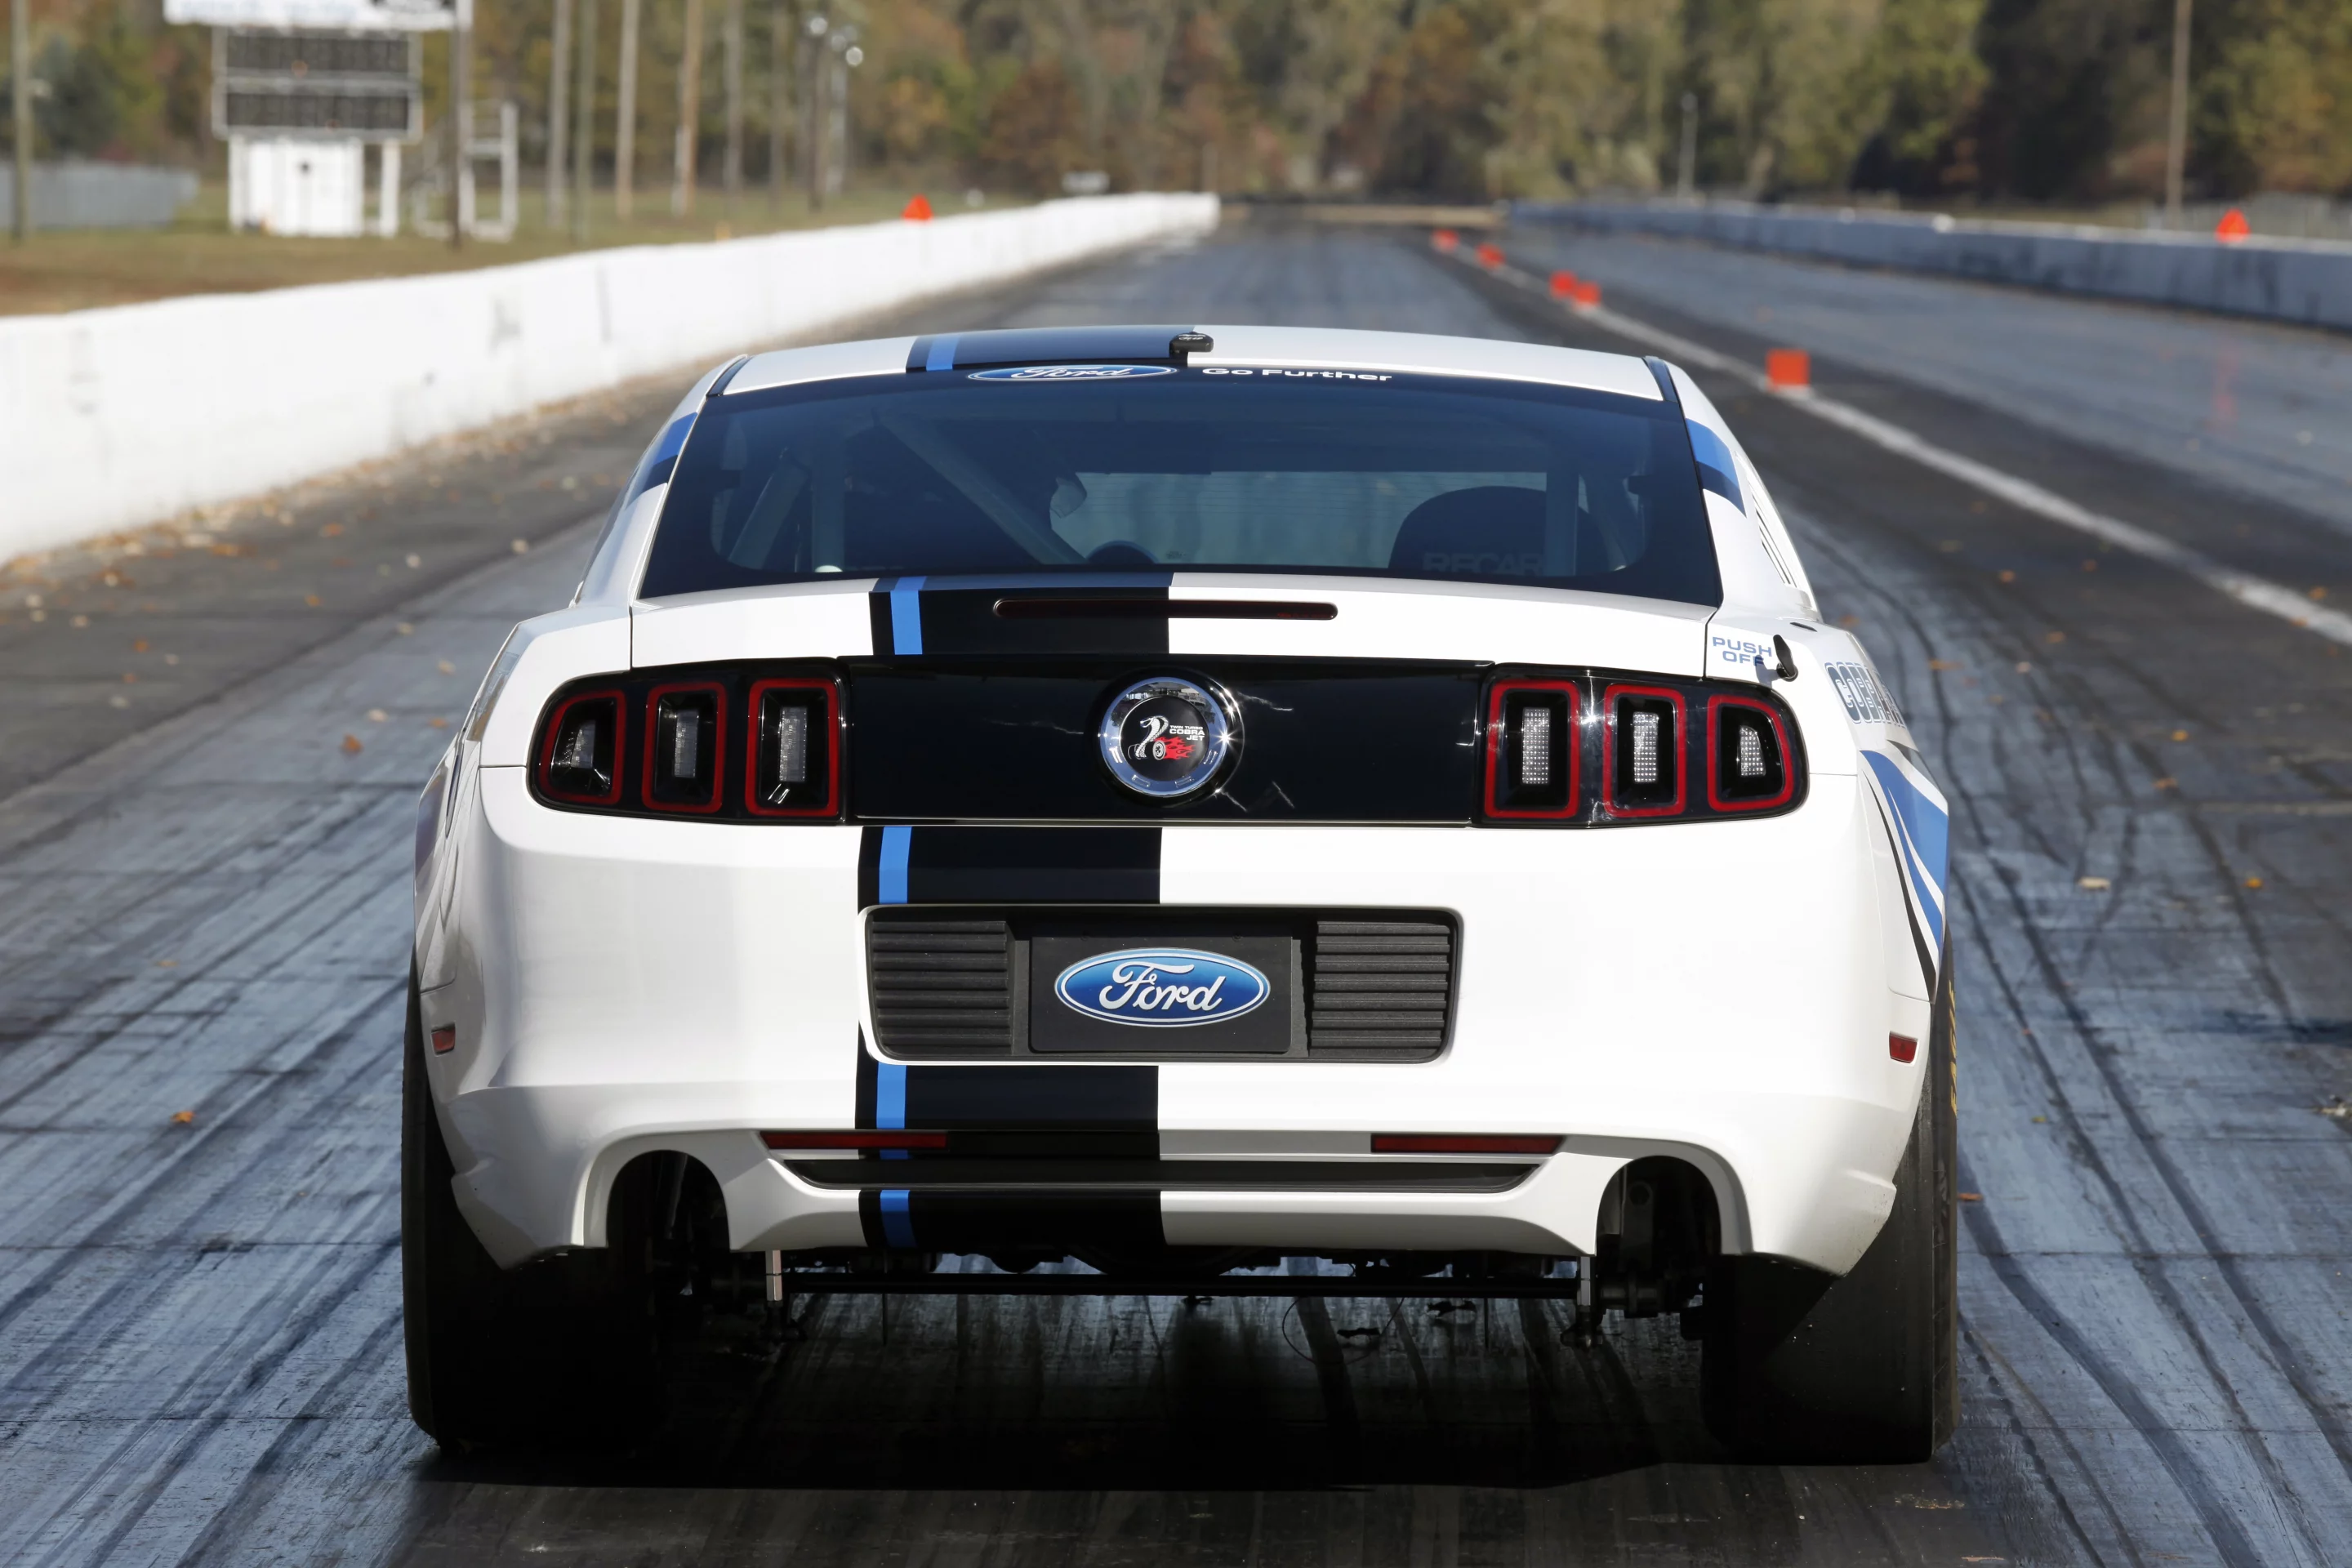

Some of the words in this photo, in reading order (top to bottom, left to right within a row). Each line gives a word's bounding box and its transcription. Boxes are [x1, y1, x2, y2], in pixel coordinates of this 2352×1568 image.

[1011, 366, 1134, 377] Ford
[1262, 369, 1392, 381] Further
[1423, 552, 1544, 577] RECAR
[1712, 636, 1772, 657] PUSH
[1722, 650, 1765, 667] OFF
[1098, 961, 1227, 1011] Ford
